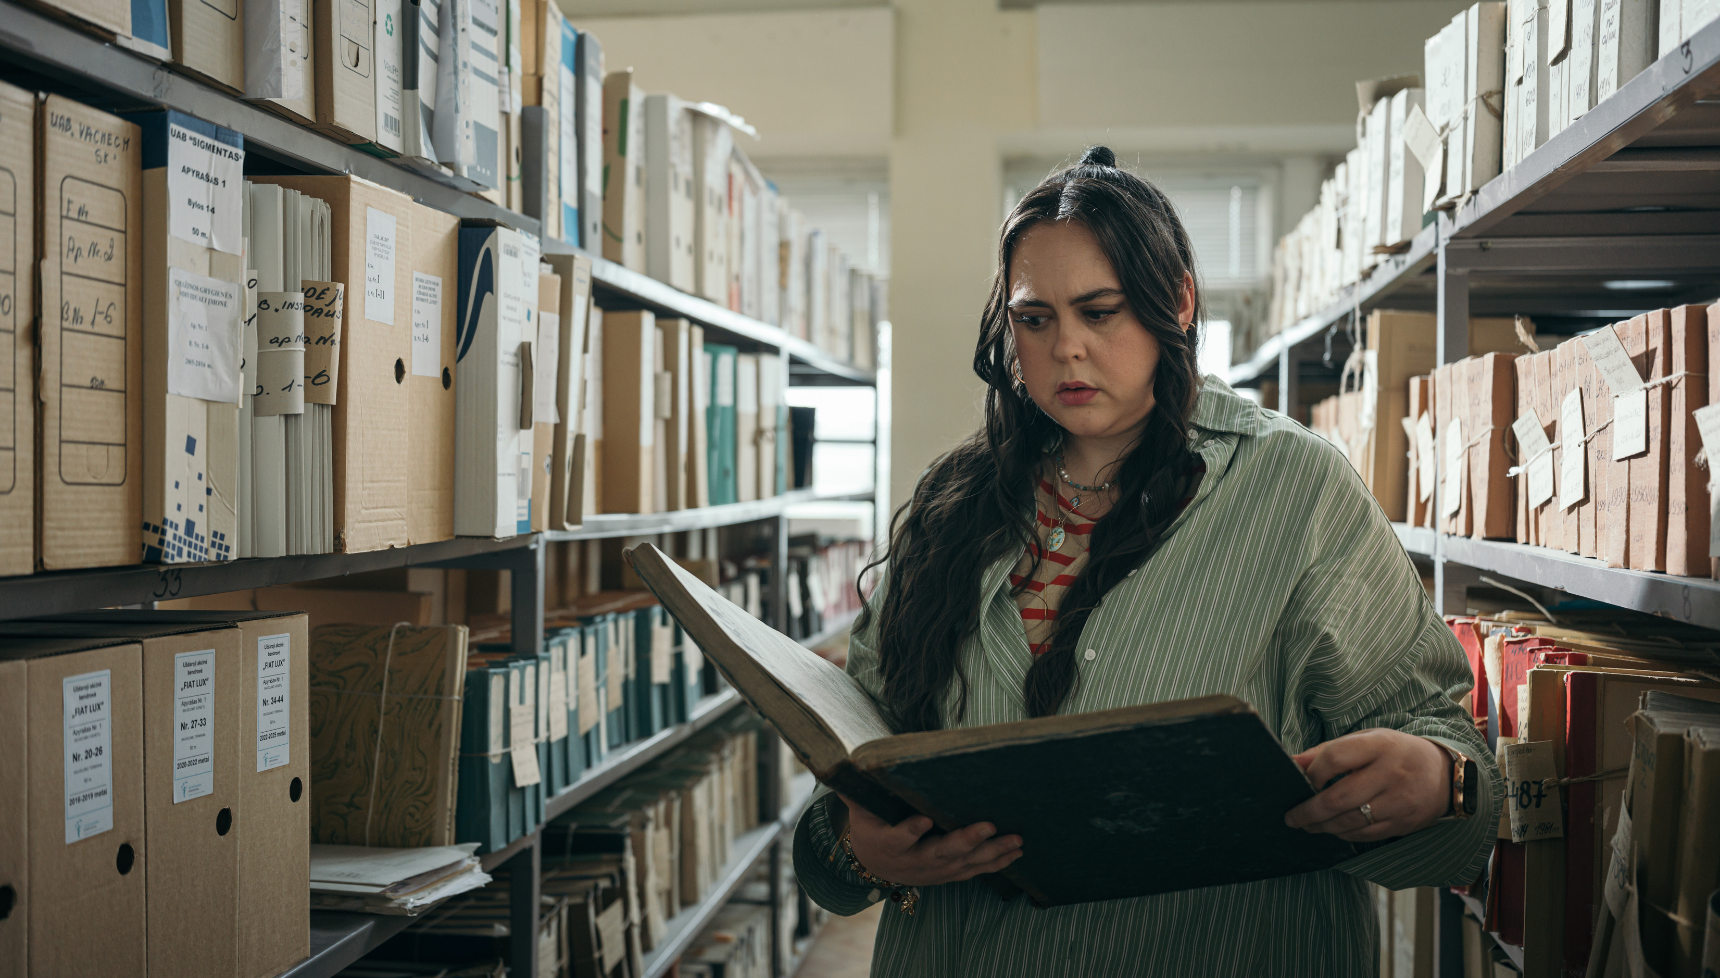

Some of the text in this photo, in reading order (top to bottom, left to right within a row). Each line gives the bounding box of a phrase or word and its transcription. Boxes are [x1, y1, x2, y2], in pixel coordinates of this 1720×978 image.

[170, 127, 187, 142] UAB
[181, 164, 226, 188] APYRAŠAS 1
[187, 198, 216, 215] Bylos 14
[192, 227, 200, 236] 50
[181, 717, 207, 731] Nr. 27-33
[73, 746, 103, 763] Nr. 20-26
[198, 756, 210, 764] metai
[94, 788, 108, 798] metai
[1508, 779, 1547, 812] 487
